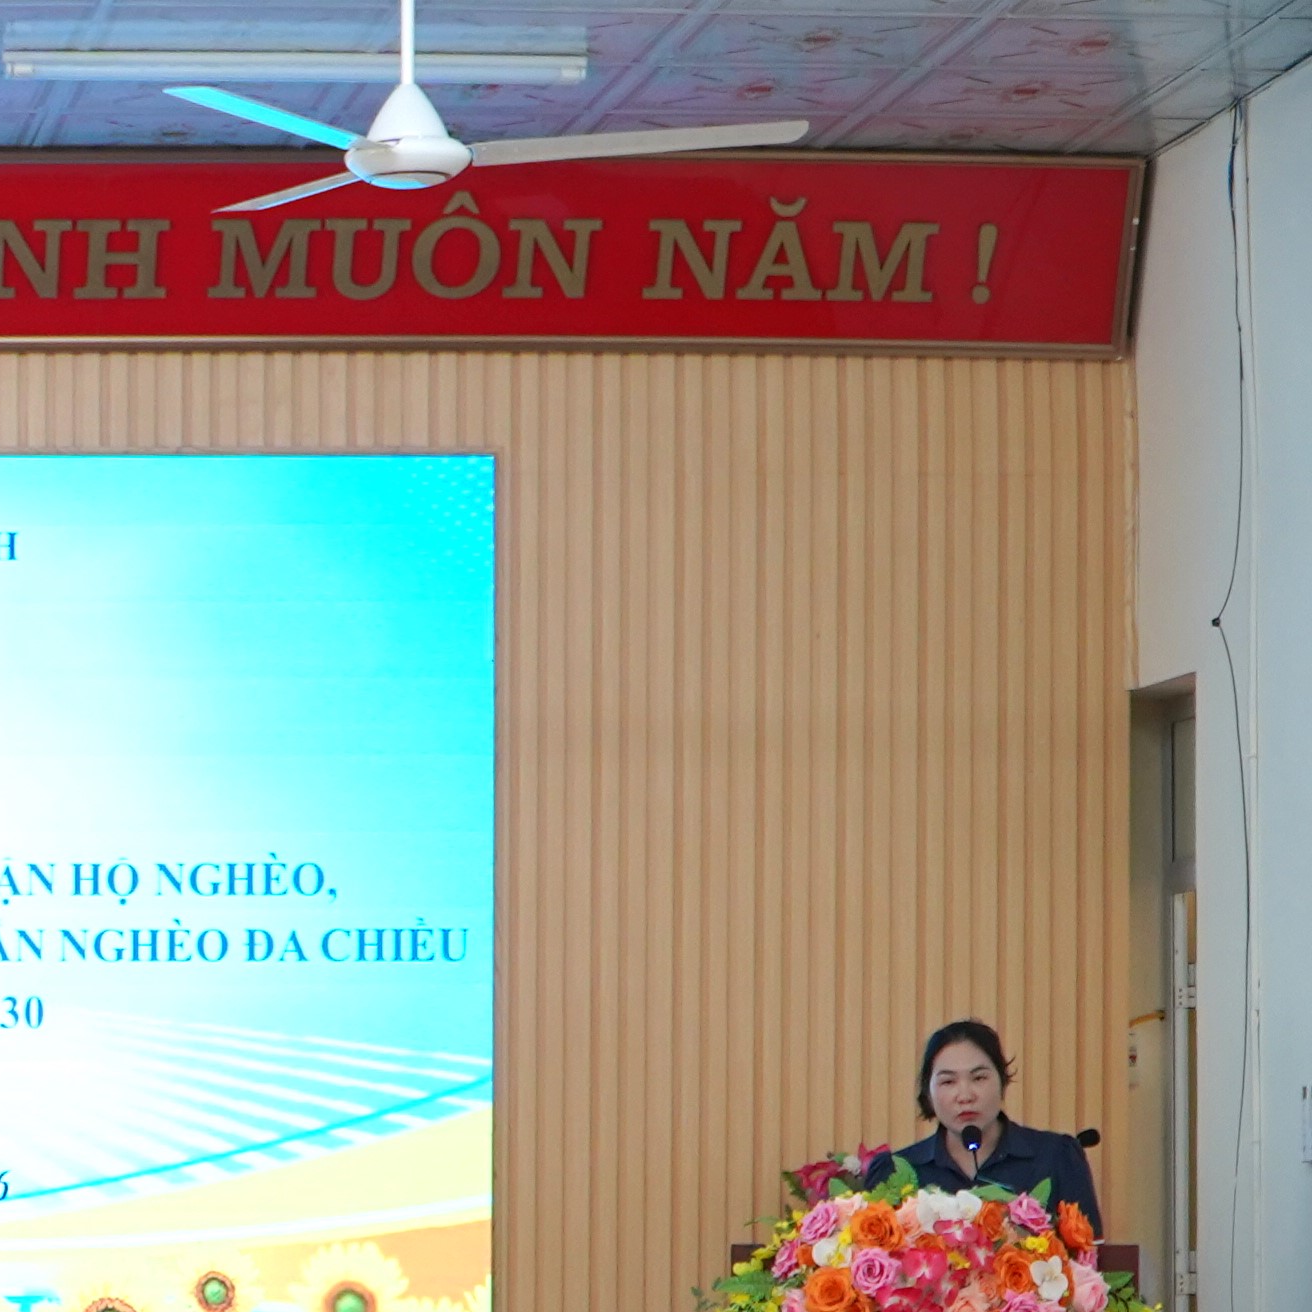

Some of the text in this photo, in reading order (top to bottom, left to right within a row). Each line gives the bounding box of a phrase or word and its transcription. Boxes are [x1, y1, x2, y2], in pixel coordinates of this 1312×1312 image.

[208, 192, 602, 299] MUÔN
[643, 198, 939, 302] NĂM
[973, 224, 997, 303] !
[72, 857, 141, 906] HỘ
[155, 853, 338, 903] NGHÈO,
[60, 919, 230, 962] NGHÈO
[245, 929, 309, 962] ĐA
[320, 918, 469, 962] CHIỀU
